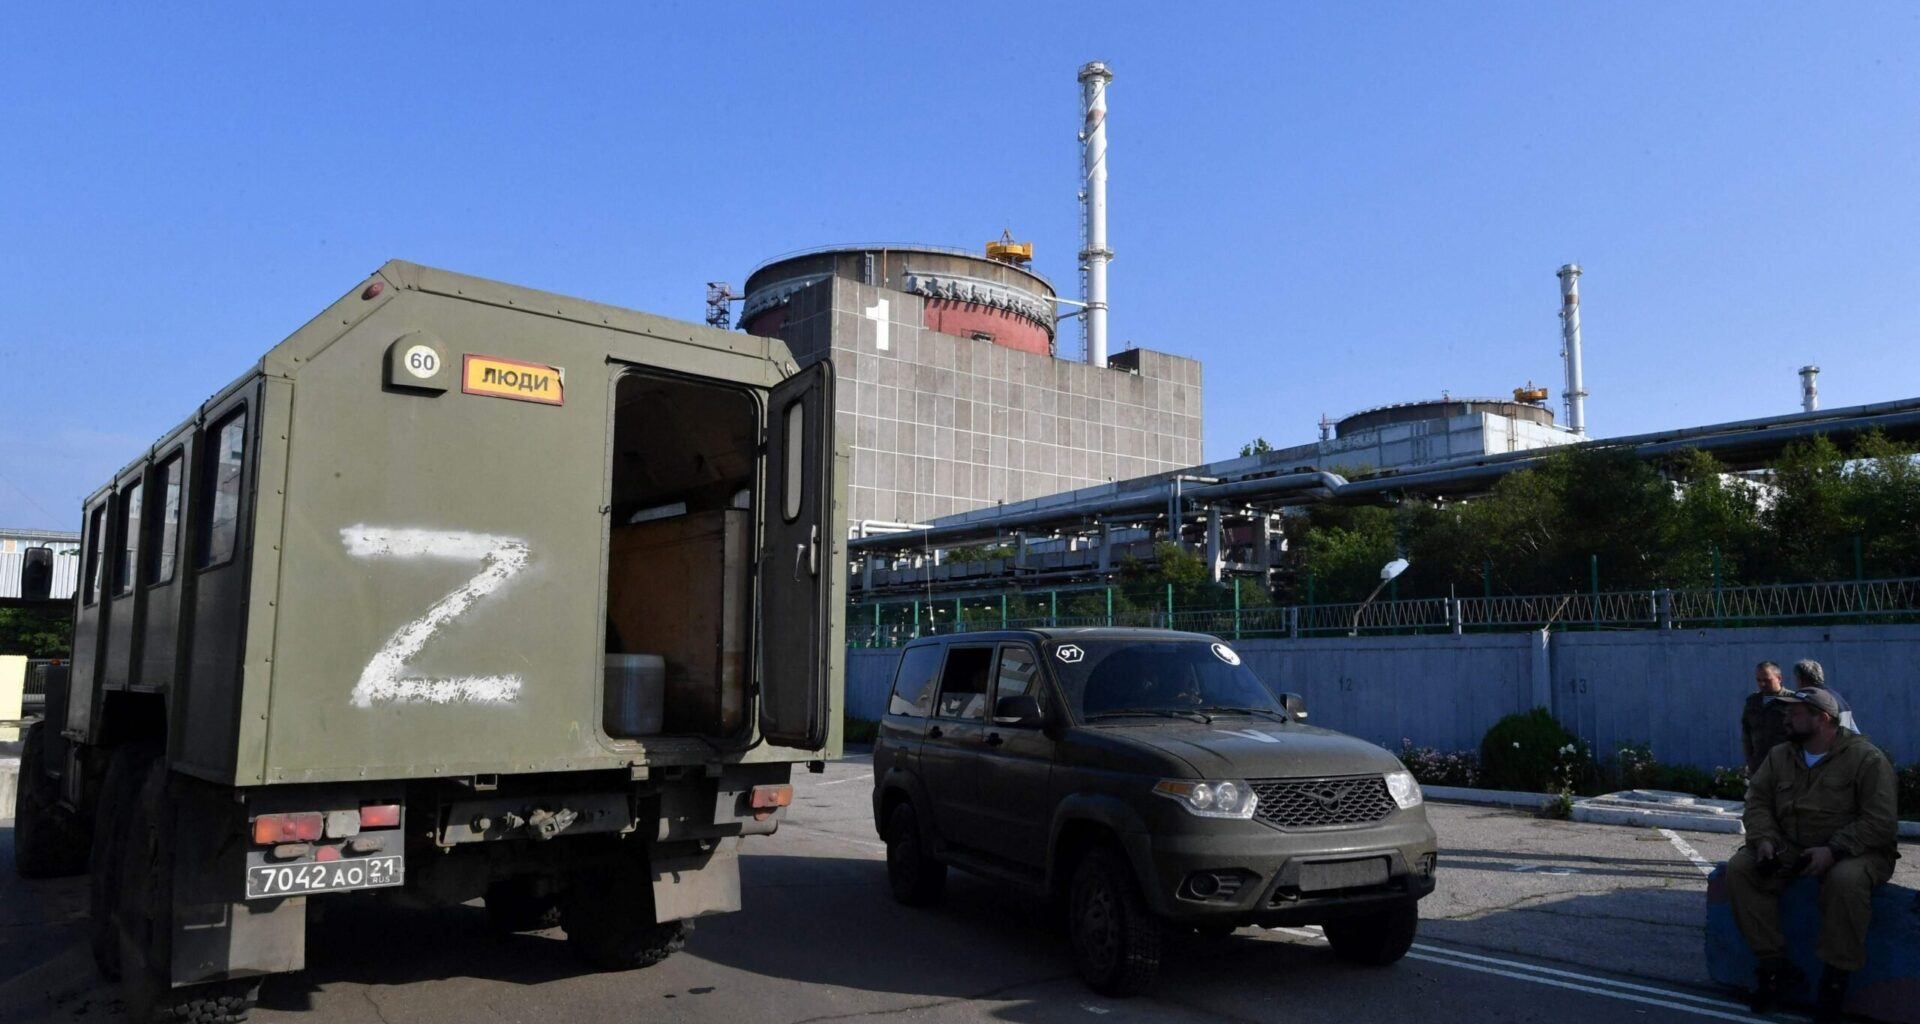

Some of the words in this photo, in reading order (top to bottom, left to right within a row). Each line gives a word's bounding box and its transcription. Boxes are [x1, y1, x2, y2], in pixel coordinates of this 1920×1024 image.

[866, 299, 889, 350] 1
[410, 353, 435, 371] 60
[482, 367, 549, 392] ЛЮДИ
[340, 523, 530, 707] Z
[1061, 649, 1077, 658] 97
[1339, 676, 1352, 691] 12
[1569, 679, 1587, 694] 13
[260, 865, 327, 893] 7042
[370, 858, 394, 878] 21
[372, 876, 391, 884] RUS
